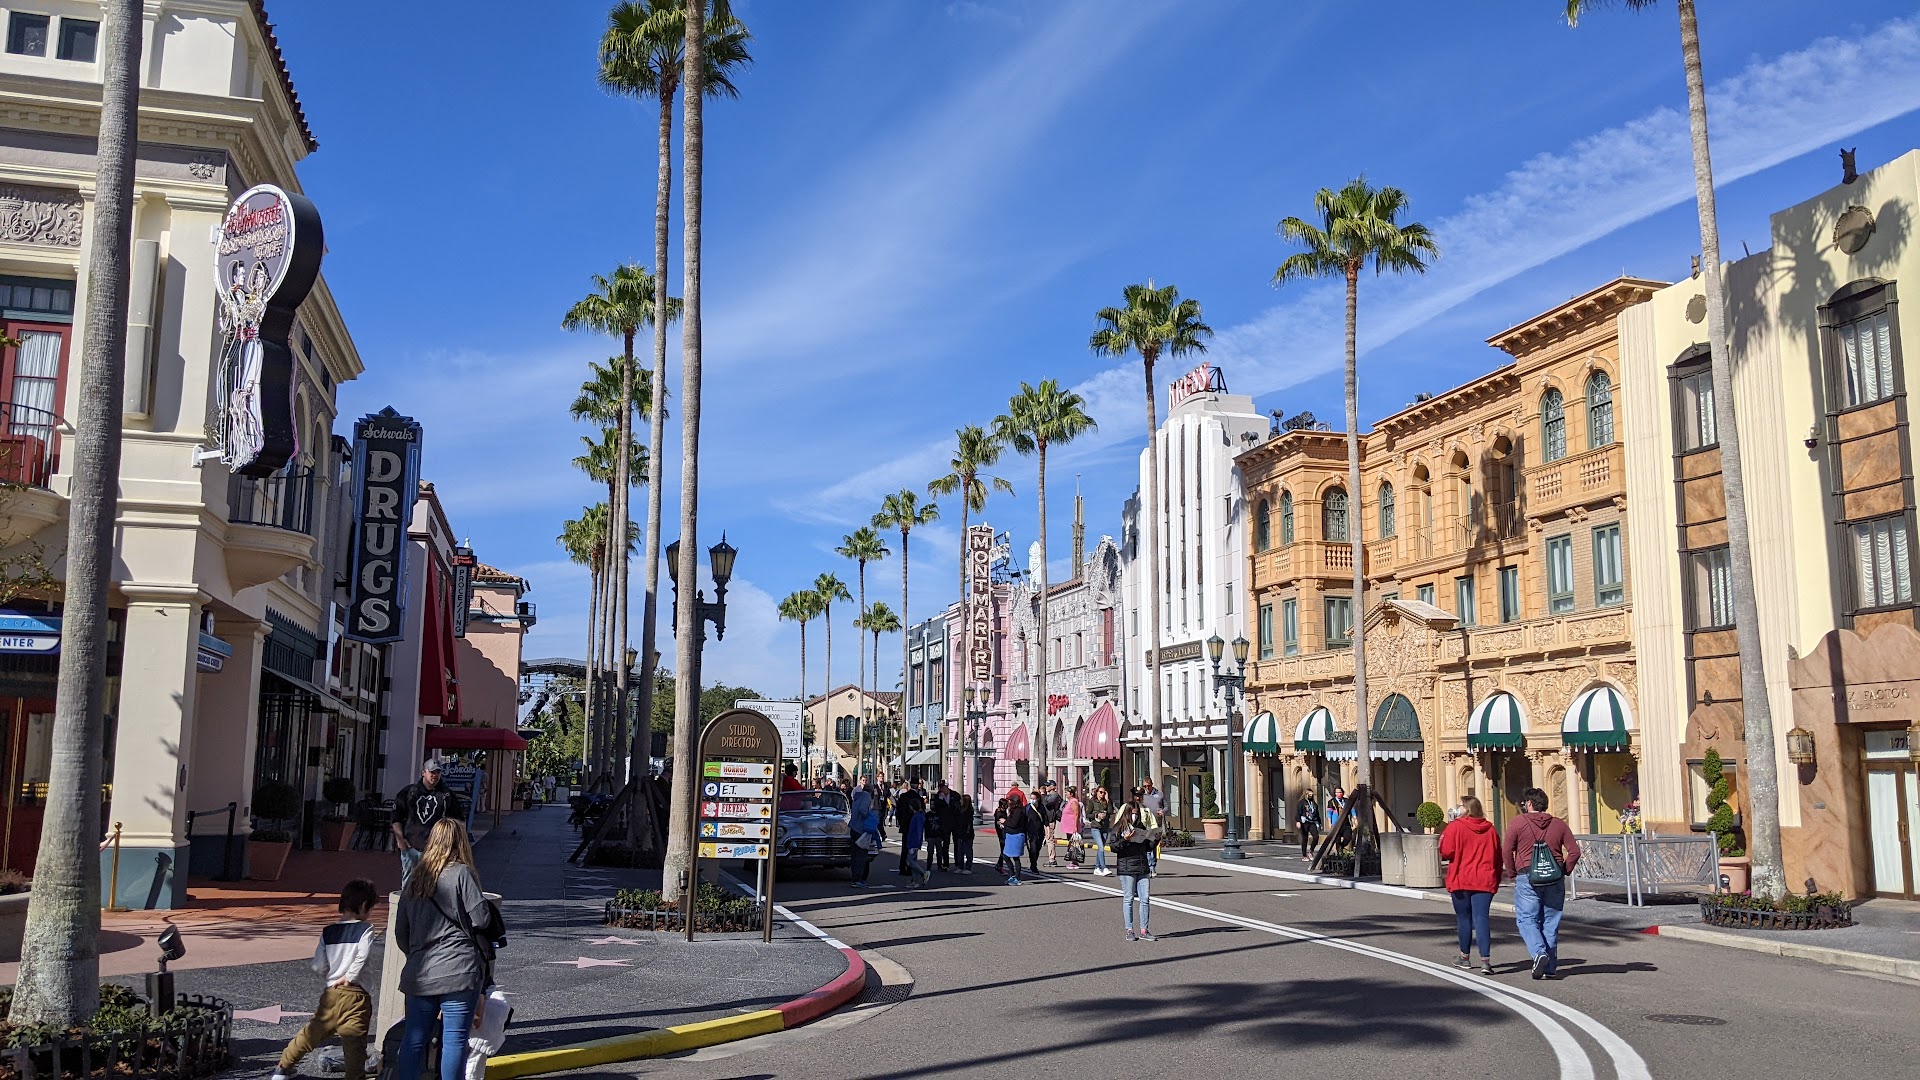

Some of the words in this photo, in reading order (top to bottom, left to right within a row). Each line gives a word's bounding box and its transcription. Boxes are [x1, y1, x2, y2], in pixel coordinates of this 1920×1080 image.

[358, 450, 402, 633] DRUGS
[455, 569, 464, 633] PROCESSING
[974, 536, 989, 679] MONTMARTRE
[0, 637, 34, 647] NTER
[1864, 687, 1910, 701] FACTOR
[729, 724, 756, 736] STUDIO
[721, 736, 761, 748] DIRECTORY
[723, 766, 748, 774] HORROR
[722, 784, 738, 795] E.T.
[721, 803, 748, 813] FIEVEL'S
[733, 844, 757, 858] RIDE
